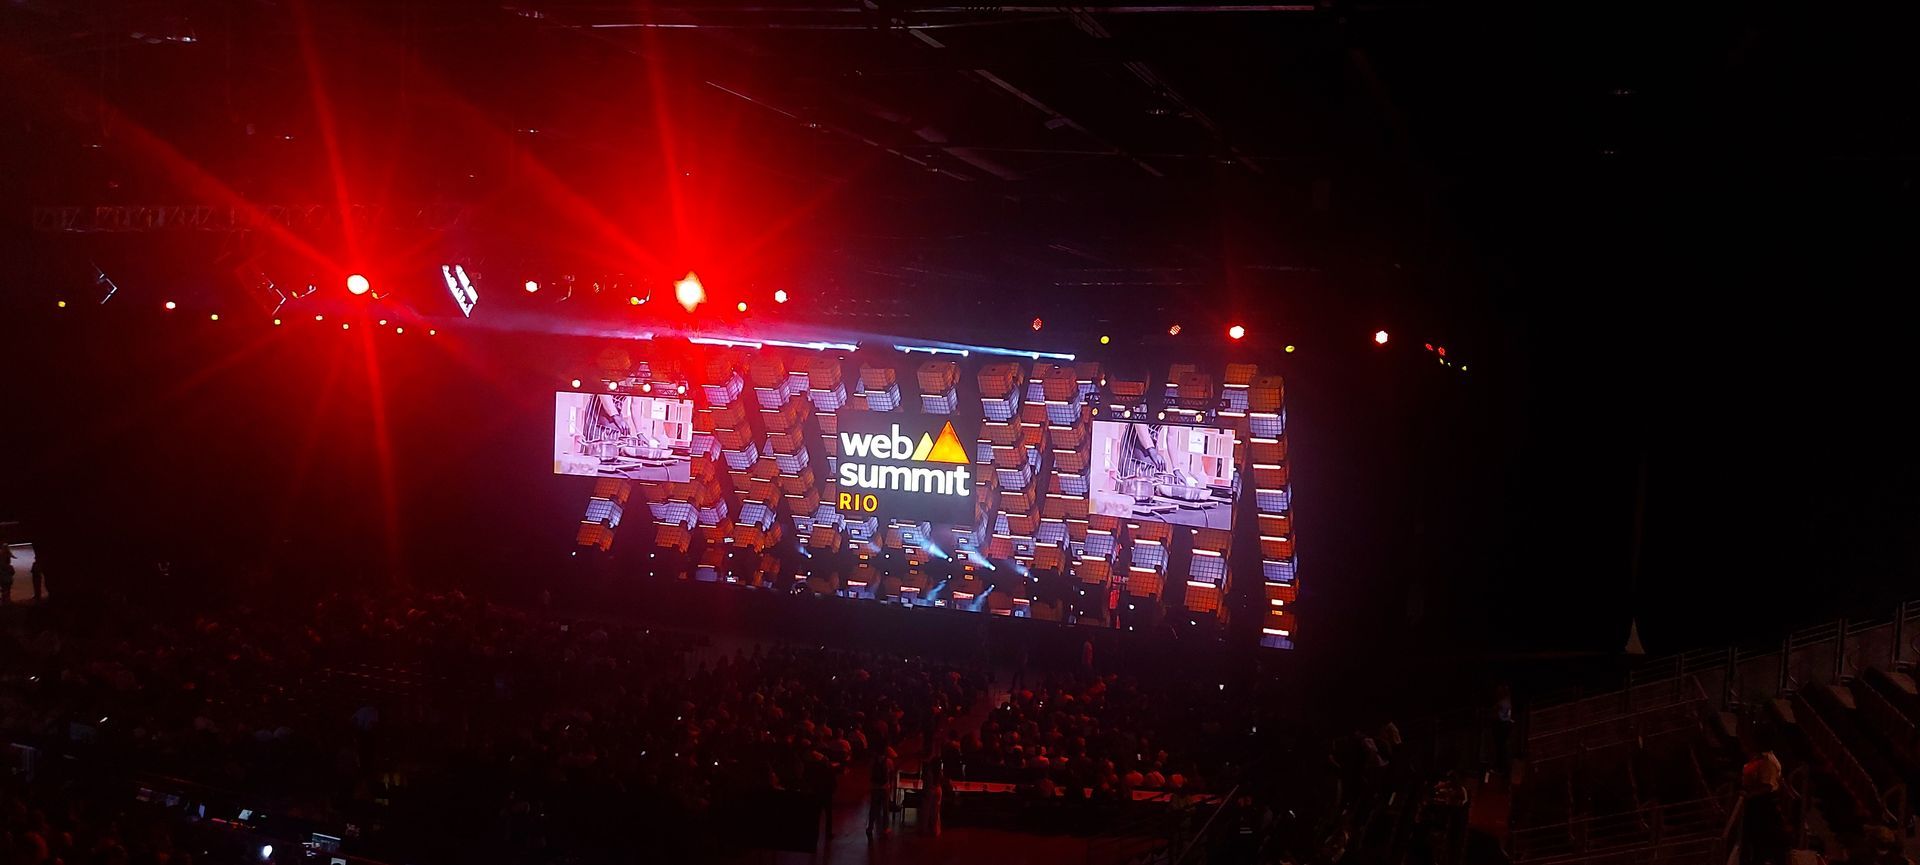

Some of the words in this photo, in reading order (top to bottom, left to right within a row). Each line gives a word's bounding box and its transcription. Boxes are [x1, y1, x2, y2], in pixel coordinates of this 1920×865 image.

[840, 423, 914, 460] web
[839, 462, 971, 497] summit
[839, 492, 879, 512] RIO
